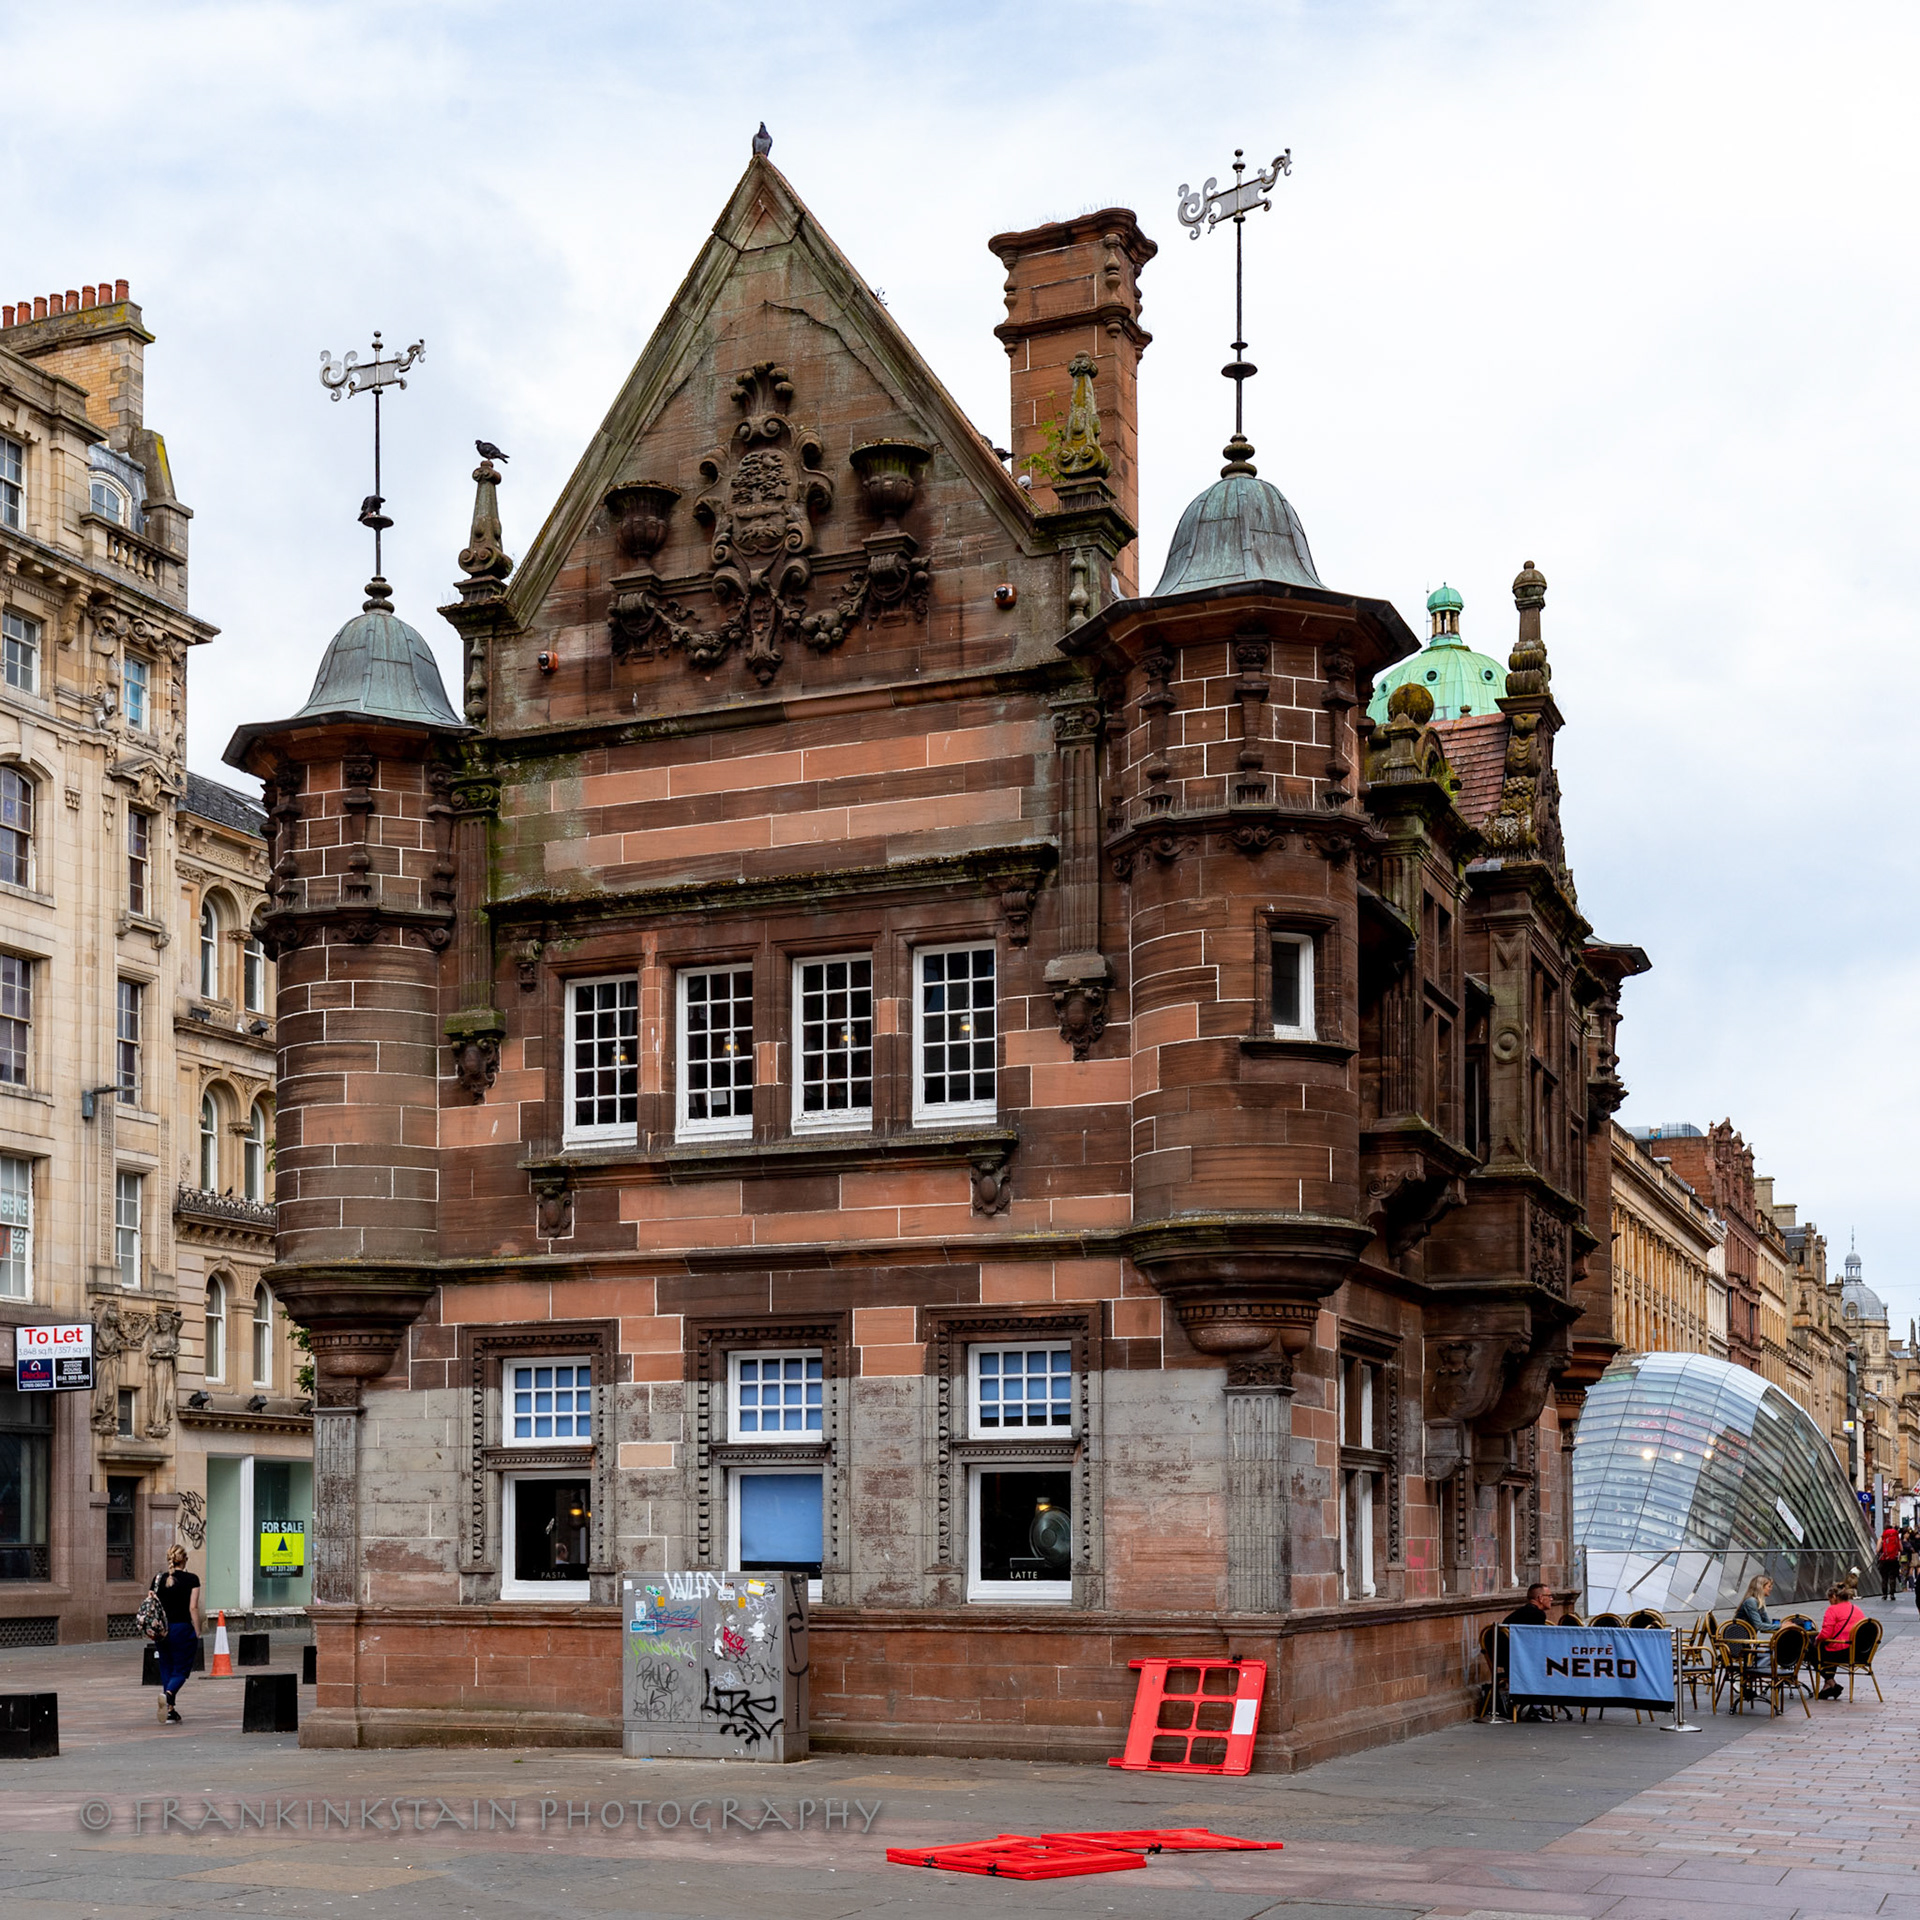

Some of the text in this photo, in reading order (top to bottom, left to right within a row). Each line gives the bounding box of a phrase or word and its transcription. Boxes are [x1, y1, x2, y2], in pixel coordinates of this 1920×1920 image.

[24, 1327, 83, 1345] To Let
[262, 1521, 304, 1533] FOR SALE
[541, 1571, 567, 1579] PASTA
[1010, 1571, 1038, 1579] LATTE
[1571, 1644, 1613, 1655] CAFFÈ
[1546, 1656, 1637, 1679] NERO
